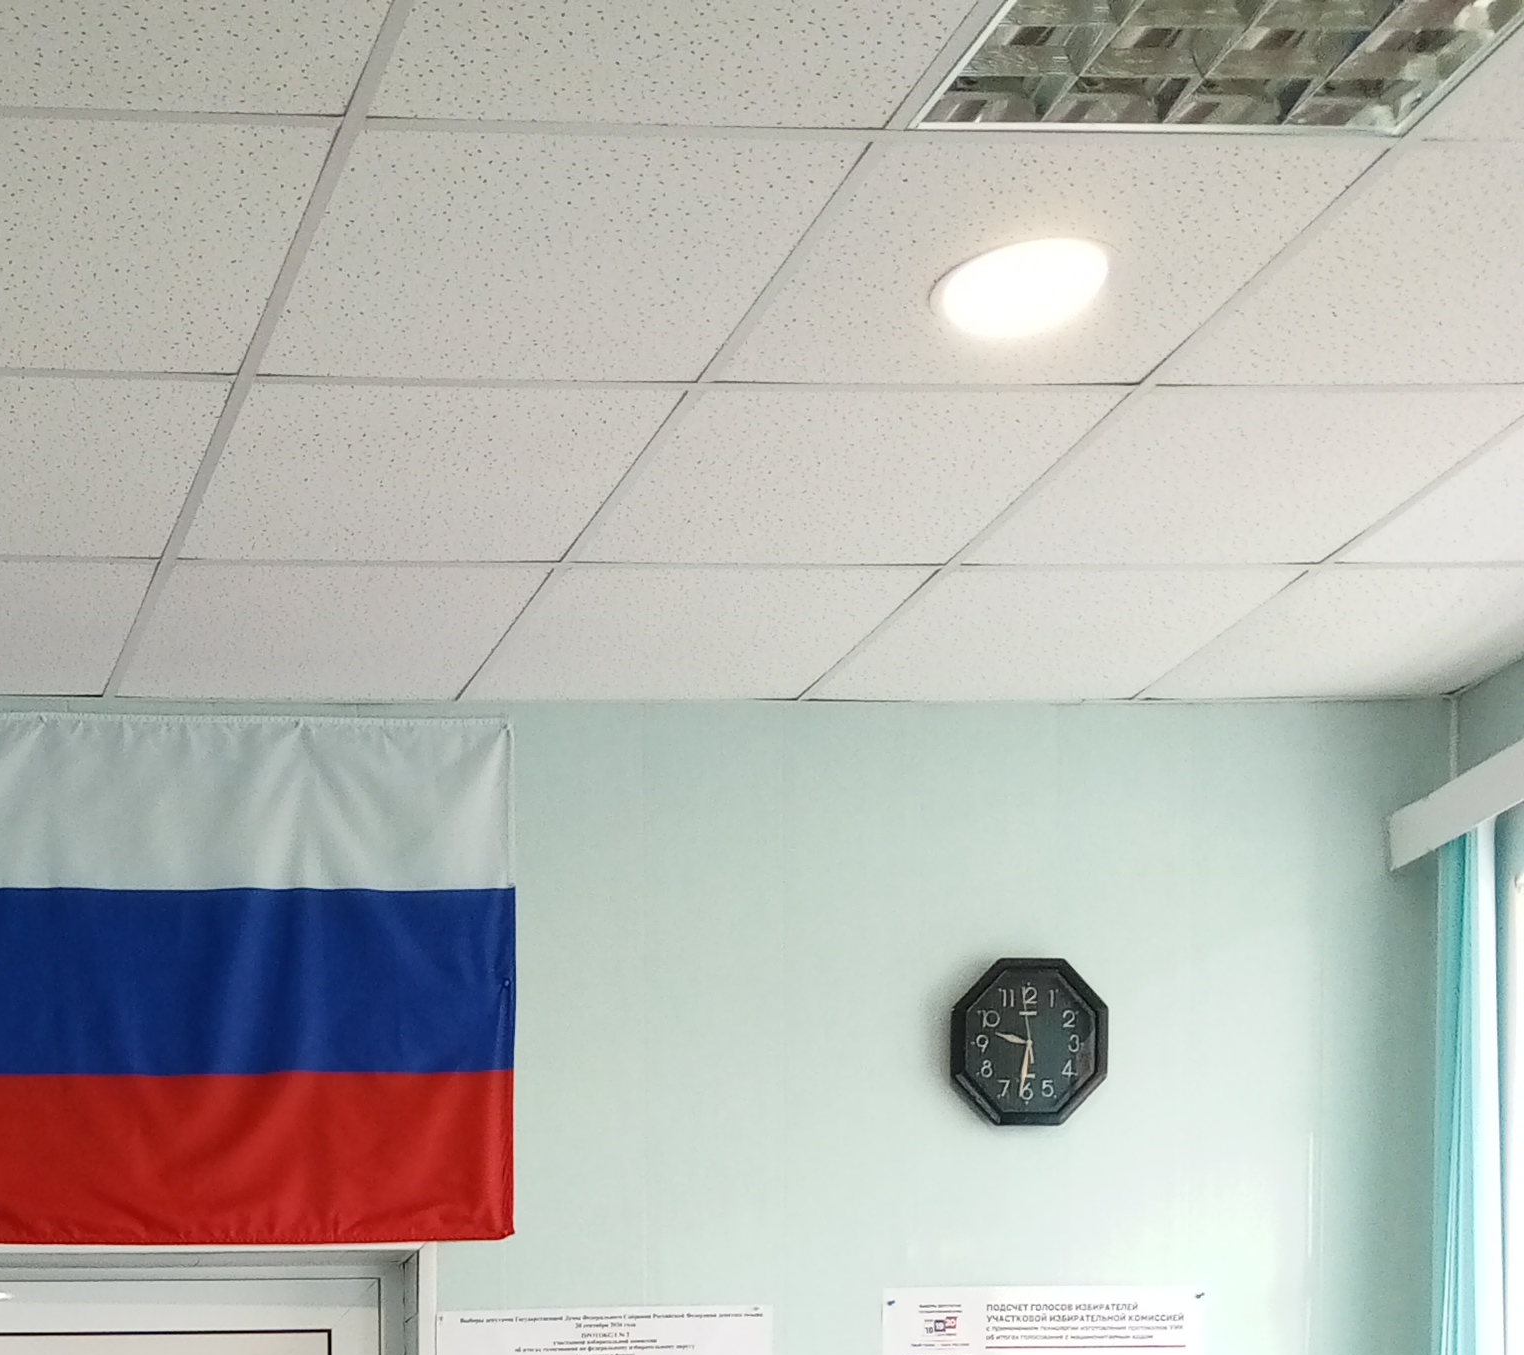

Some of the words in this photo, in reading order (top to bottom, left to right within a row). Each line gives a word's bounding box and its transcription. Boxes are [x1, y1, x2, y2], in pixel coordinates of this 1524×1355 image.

[1002, 989, 1014, 1006] 11
[1022, 986, 1038, 1004] 12
[982, 1010, 1000, 1028] 10
[1062, 1010, 1076, 1028] 2
[976, 1035, 988, 1052] 9
[1068, 1035, 1080, 1052] 3
[981, 1060, 993, 1078] 8
[1062, 1060, 1074, 1076] 4
[998, 1080, 1010, 1096] 7
[1022, 1082, 1034, 1100] 6
[1042, 1080, 1054, 1097] 5
[986, 1304, 1028, 1312] ПОДСЧЕТ
[1076, 1302, 1138, 1311] ИЗБИРАТЕЛЕЙ
[986, 1313, 1047, 1322] УЧАСТКОВОЙ
[1050, 1313, 1126, 1322] ИЗБИРАТЕЛЬНОЙ
[1128, 1313, 1184, 1322] КОМИССИЕЙ
